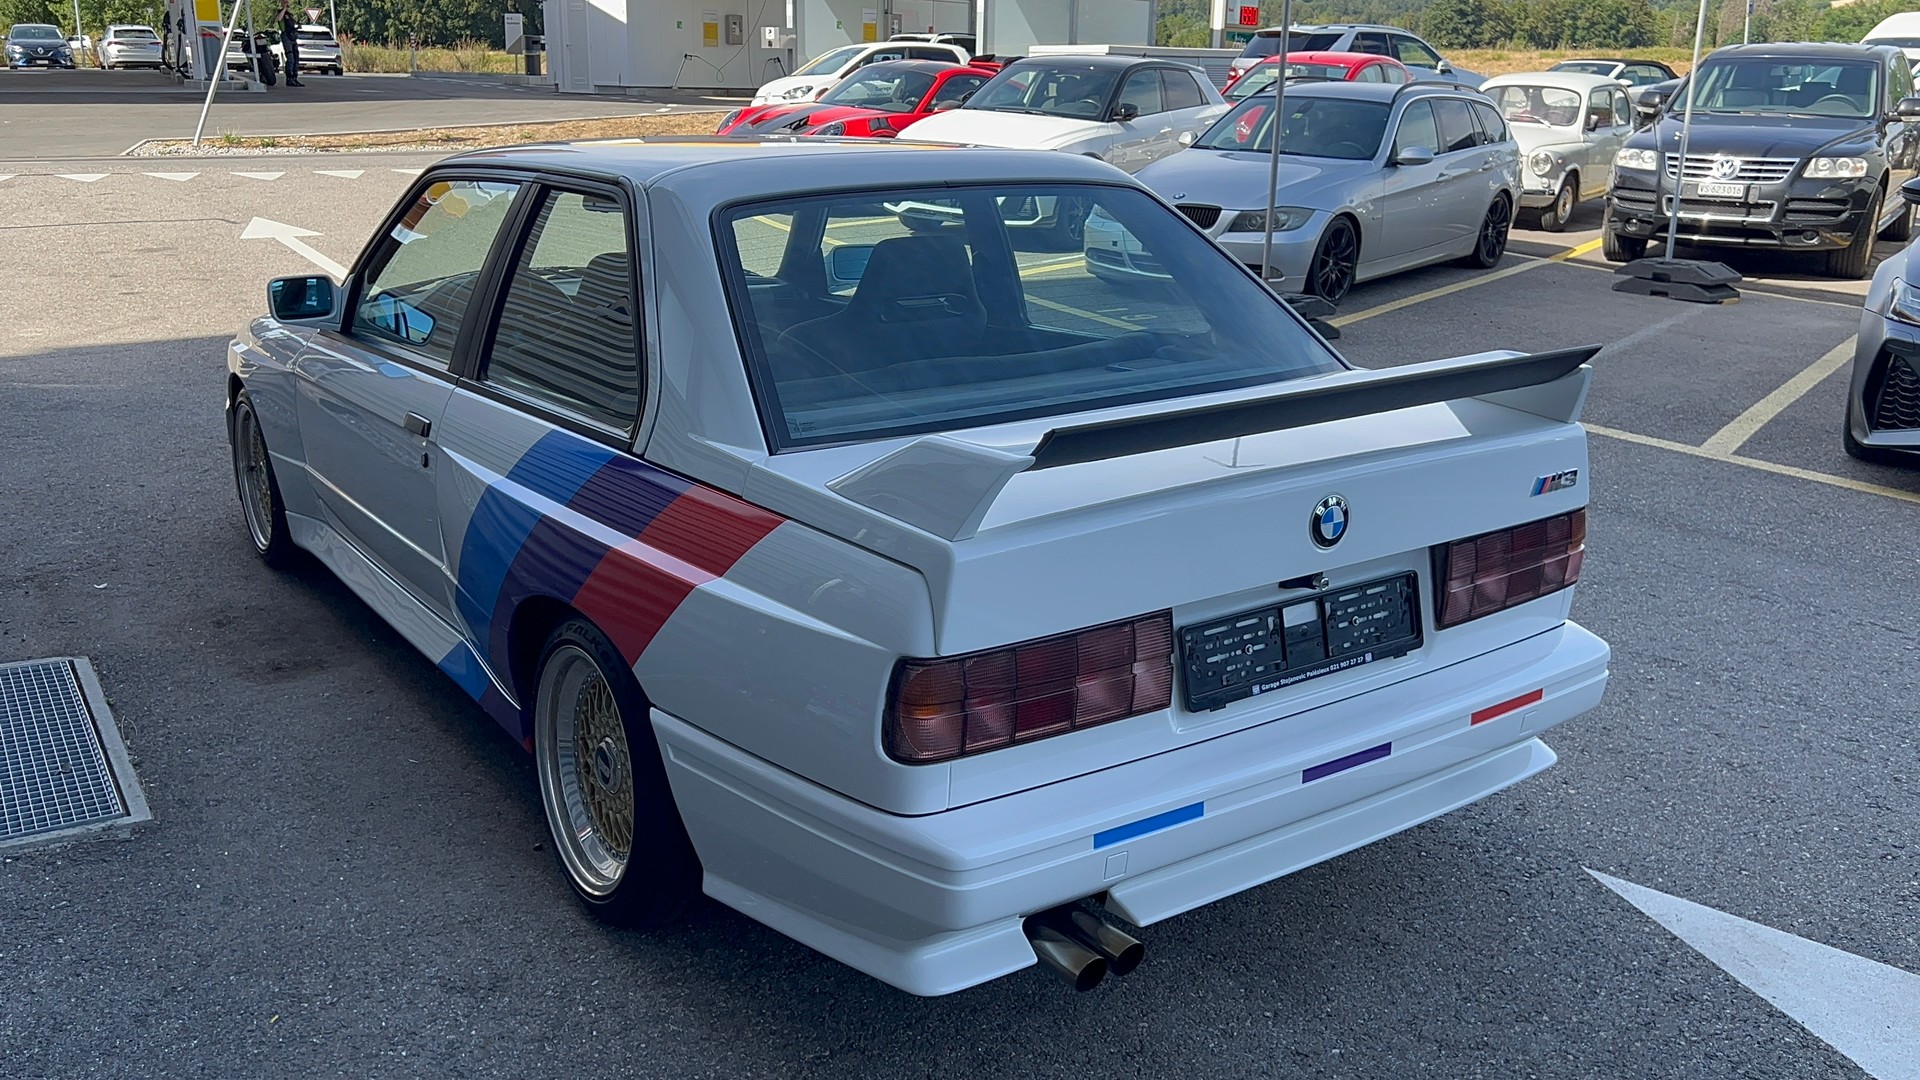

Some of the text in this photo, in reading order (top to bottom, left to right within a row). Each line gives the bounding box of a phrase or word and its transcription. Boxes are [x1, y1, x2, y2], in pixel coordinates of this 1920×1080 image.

[1700, 185, 1709, 193] VS
[1545, 468, 1578, 492] M3
[1315, 496, 1347, 517] BMW
[1261, 680, 1280, 690] Garage
[1280, 673, 1306, 685] Stojanovic
[1330, 663, 1340, 671] 021
[1340, 659, 1349, 668] 907
[1350, 658, 1357, 666] 27
[1357, 656, 1364, 664] 27
